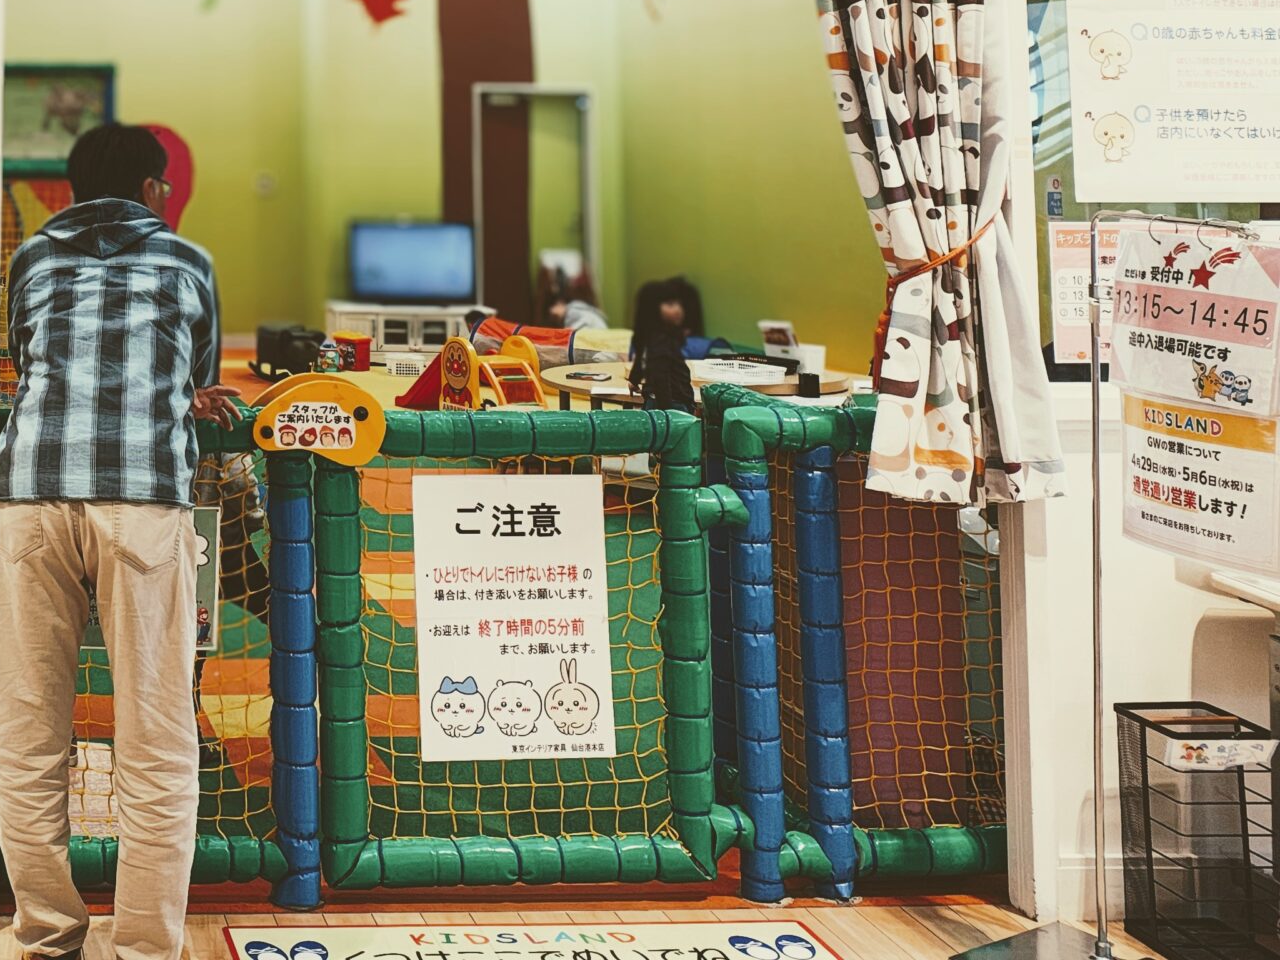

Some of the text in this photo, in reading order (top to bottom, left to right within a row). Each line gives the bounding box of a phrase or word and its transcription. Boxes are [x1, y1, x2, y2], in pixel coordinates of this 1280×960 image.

[1152, 27, 1280, 40] 0歳の赤ちゃんも料金
[1155, 109, 1247, 121] 子供を預けたら
[1116, 289, 1269, 336] 13:15～14:45
[292, 405, 338, 413] スタッフが
[278, 414, 351, 424] ご案内いたします
[1144, 408, 1223, 436] KIDSLAND
[1147, 436, 1221, 461] GWの営業について
[456, 502, 561, 537] ご注意
[500, 643, 596, 655] まで、お願いします。
[410, 931, 636, 945] KIDSLAND
